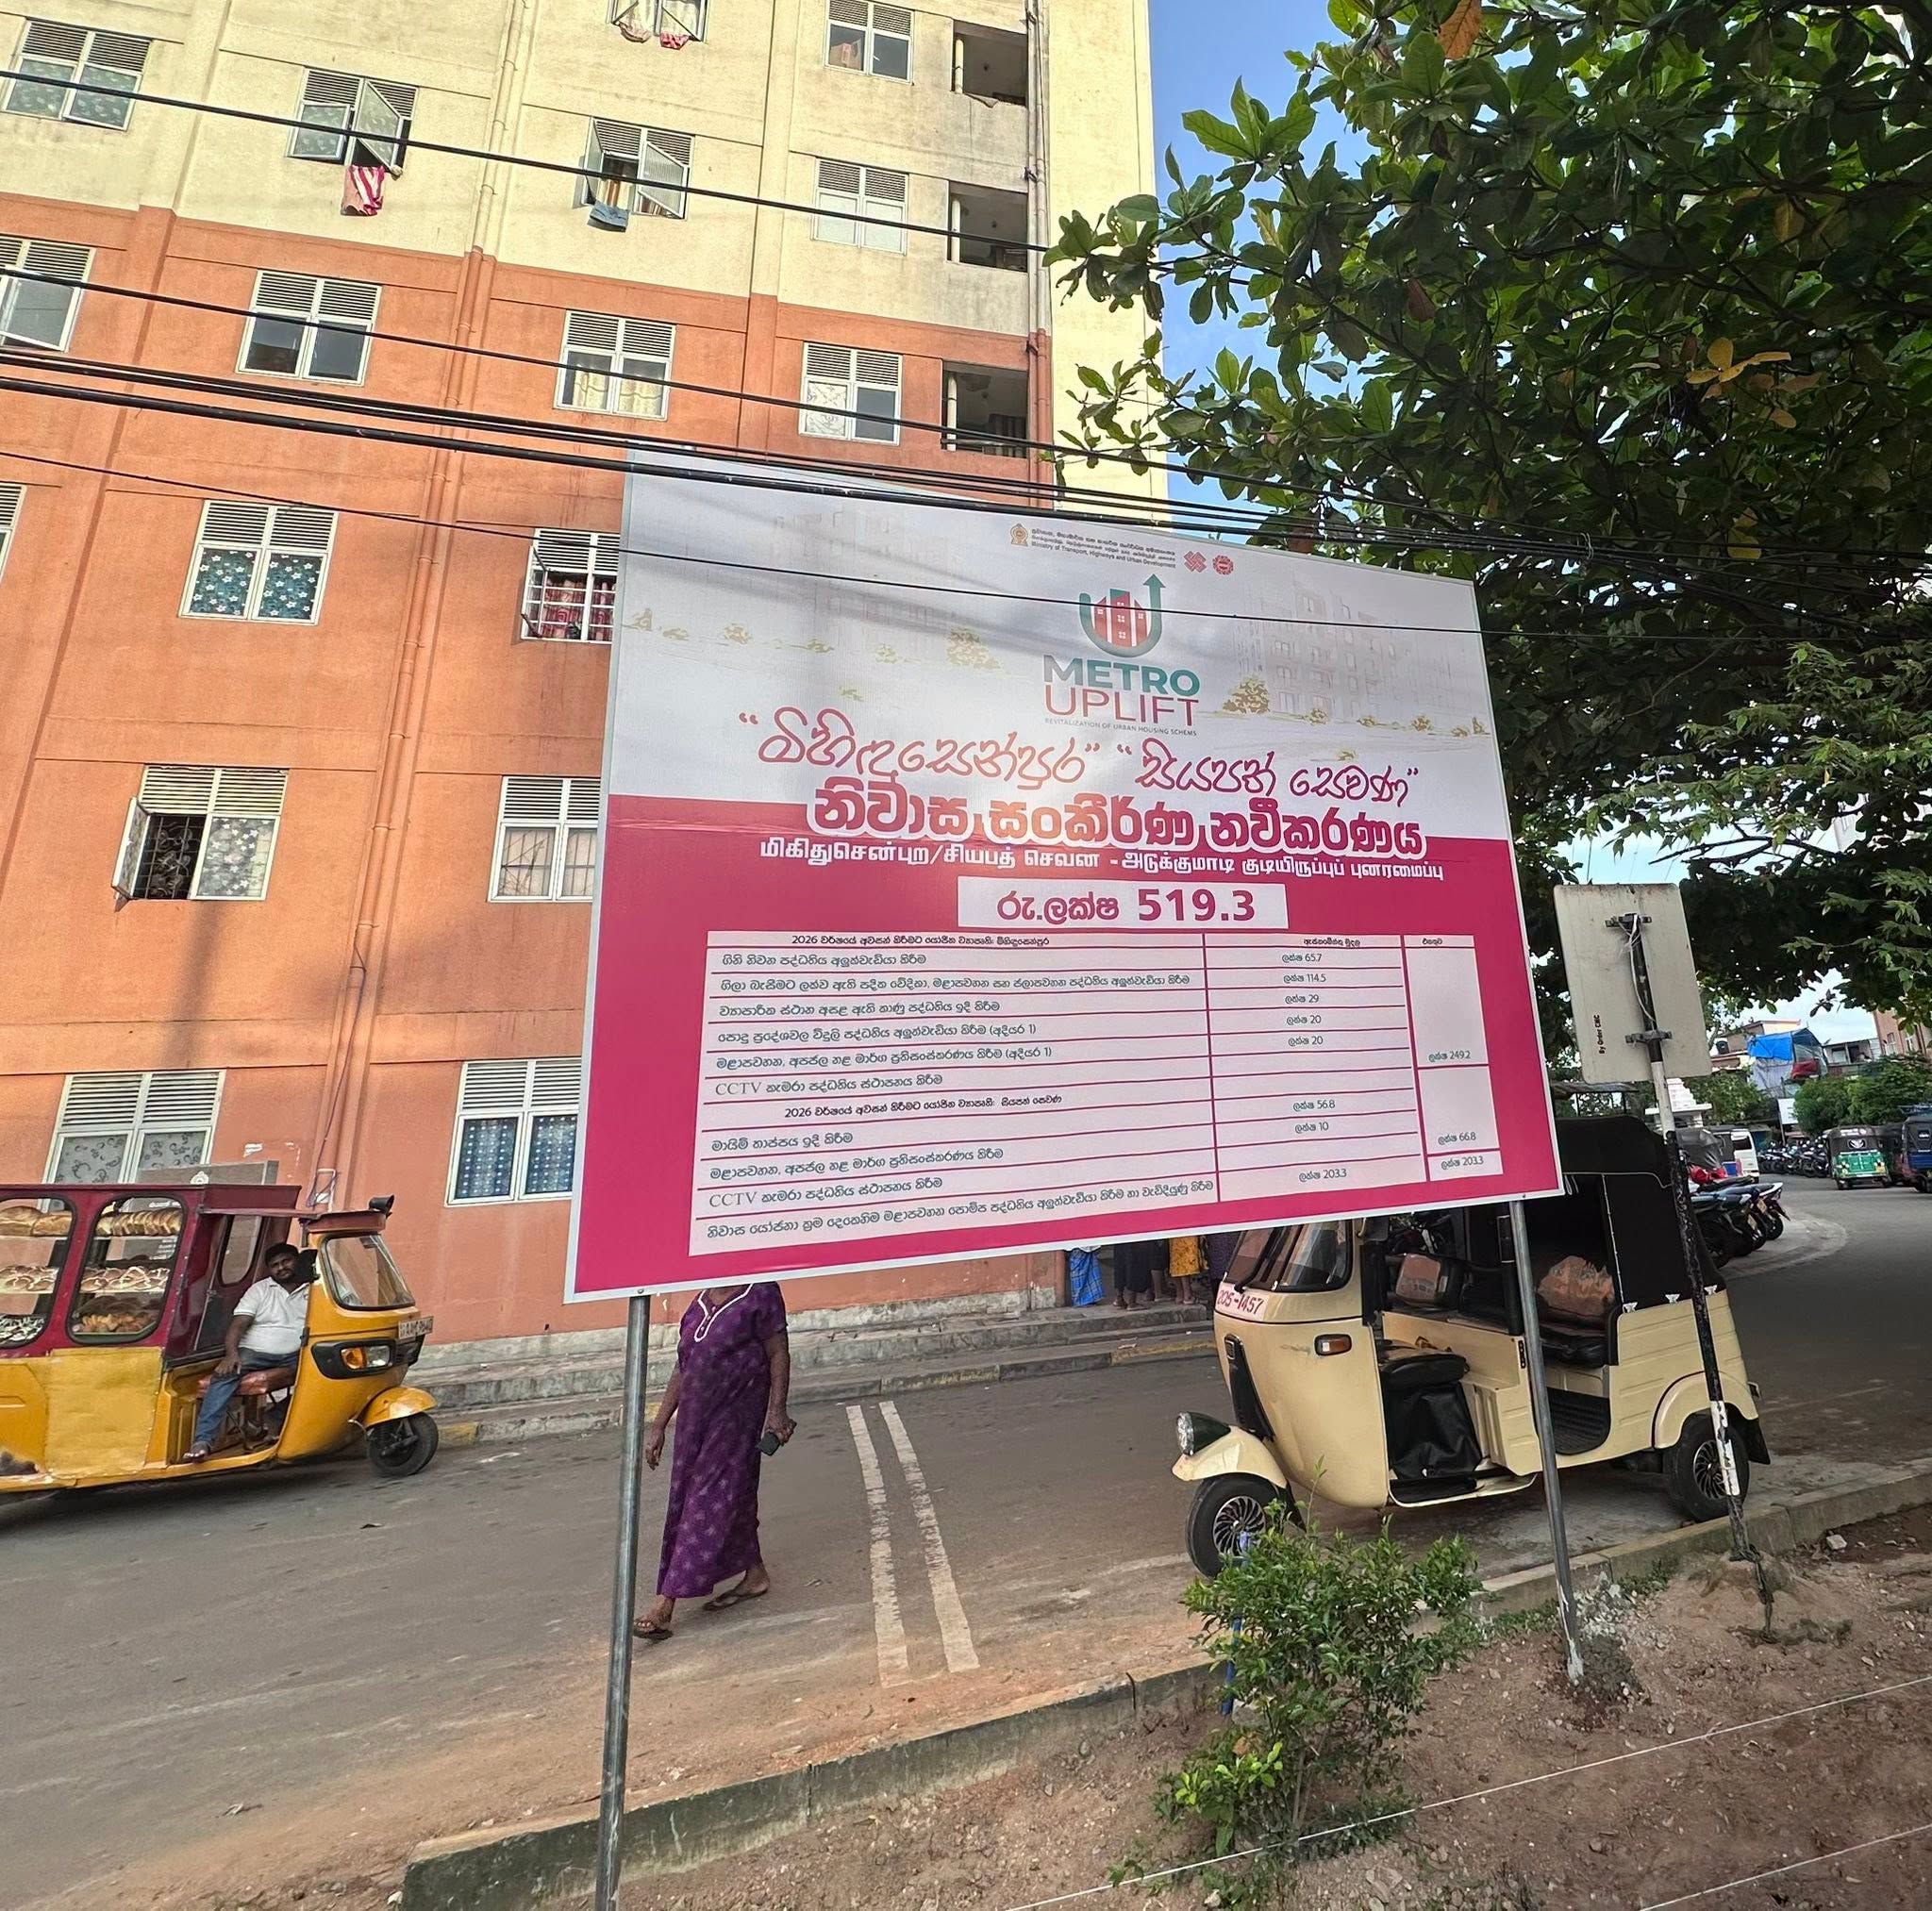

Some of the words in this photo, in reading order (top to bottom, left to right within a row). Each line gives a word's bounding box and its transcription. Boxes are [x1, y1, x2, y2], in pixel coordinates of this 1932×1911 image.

[1031, 540, 1053, 550] Ministry
[1061, 545, 1089, 557] Transport,
[1127, 556, 1142, 565] Urban
[1142, 558, 1176, 569] Development
[1043, 655, 1200, 696] METRO
[1045, 685, 1199, 726] UPLIFT
[1045, 718, 1101, 729] REVITALIZATION
[1113, 723, 1136, 732] URBAN
[1138, 725, 1169, 735] HOUSING
[1170, 728, 1197, 737] SCHEMS
[813, 775, 969, 837] නිවාස
[989, 793, 1195, 847] සංකීර්ණ
[1209, 797, 1422, 855] නවීකරණය
[1138, 889, 1256, 922] 519.3
[723, 954, 742, 965] ගිනි
[1308, 994, 1319, 1003] 29
[1310, 1015, 1322, 1023] 20
[1029, 1024, 1036, 1034] 1)
[1311, 1036, 1323, 1044] 20
[1044, 1047, 1052, 1056] 1)
[715, 1080, 762, 1097] CCTV
[785, 1107, 811, 1118] 2026
[1319, 1122, 1328, 1131] 10
[708, 1191, 758, 1208] CCTV
